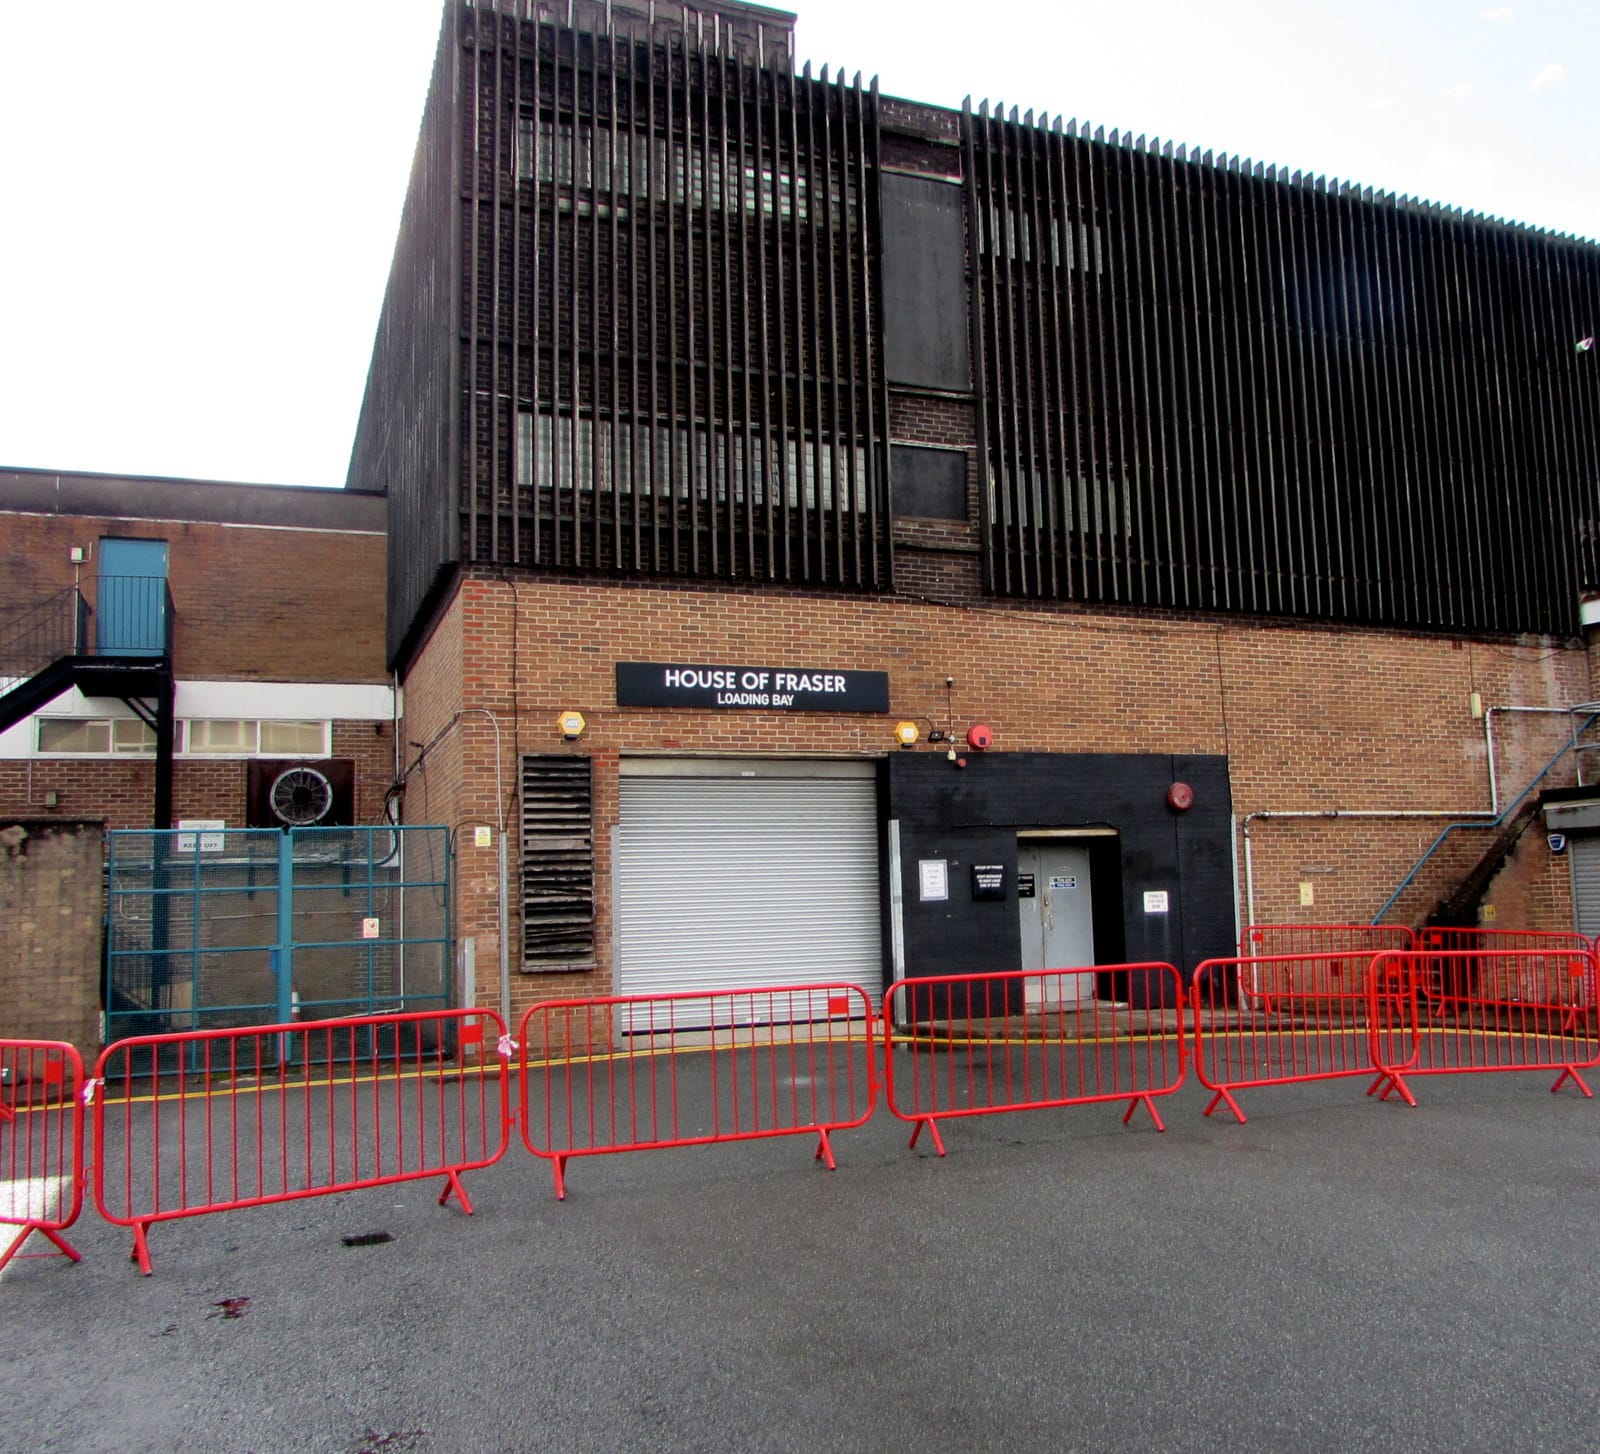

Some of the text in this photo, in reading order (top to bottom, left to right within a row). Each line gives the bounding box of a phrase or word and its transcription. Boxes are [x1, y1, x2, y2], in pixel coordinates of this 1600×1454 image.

[664, 669, 847, 693] HOUSE OF FRASER
[717, 692, 795, 707] LOADING BAY
